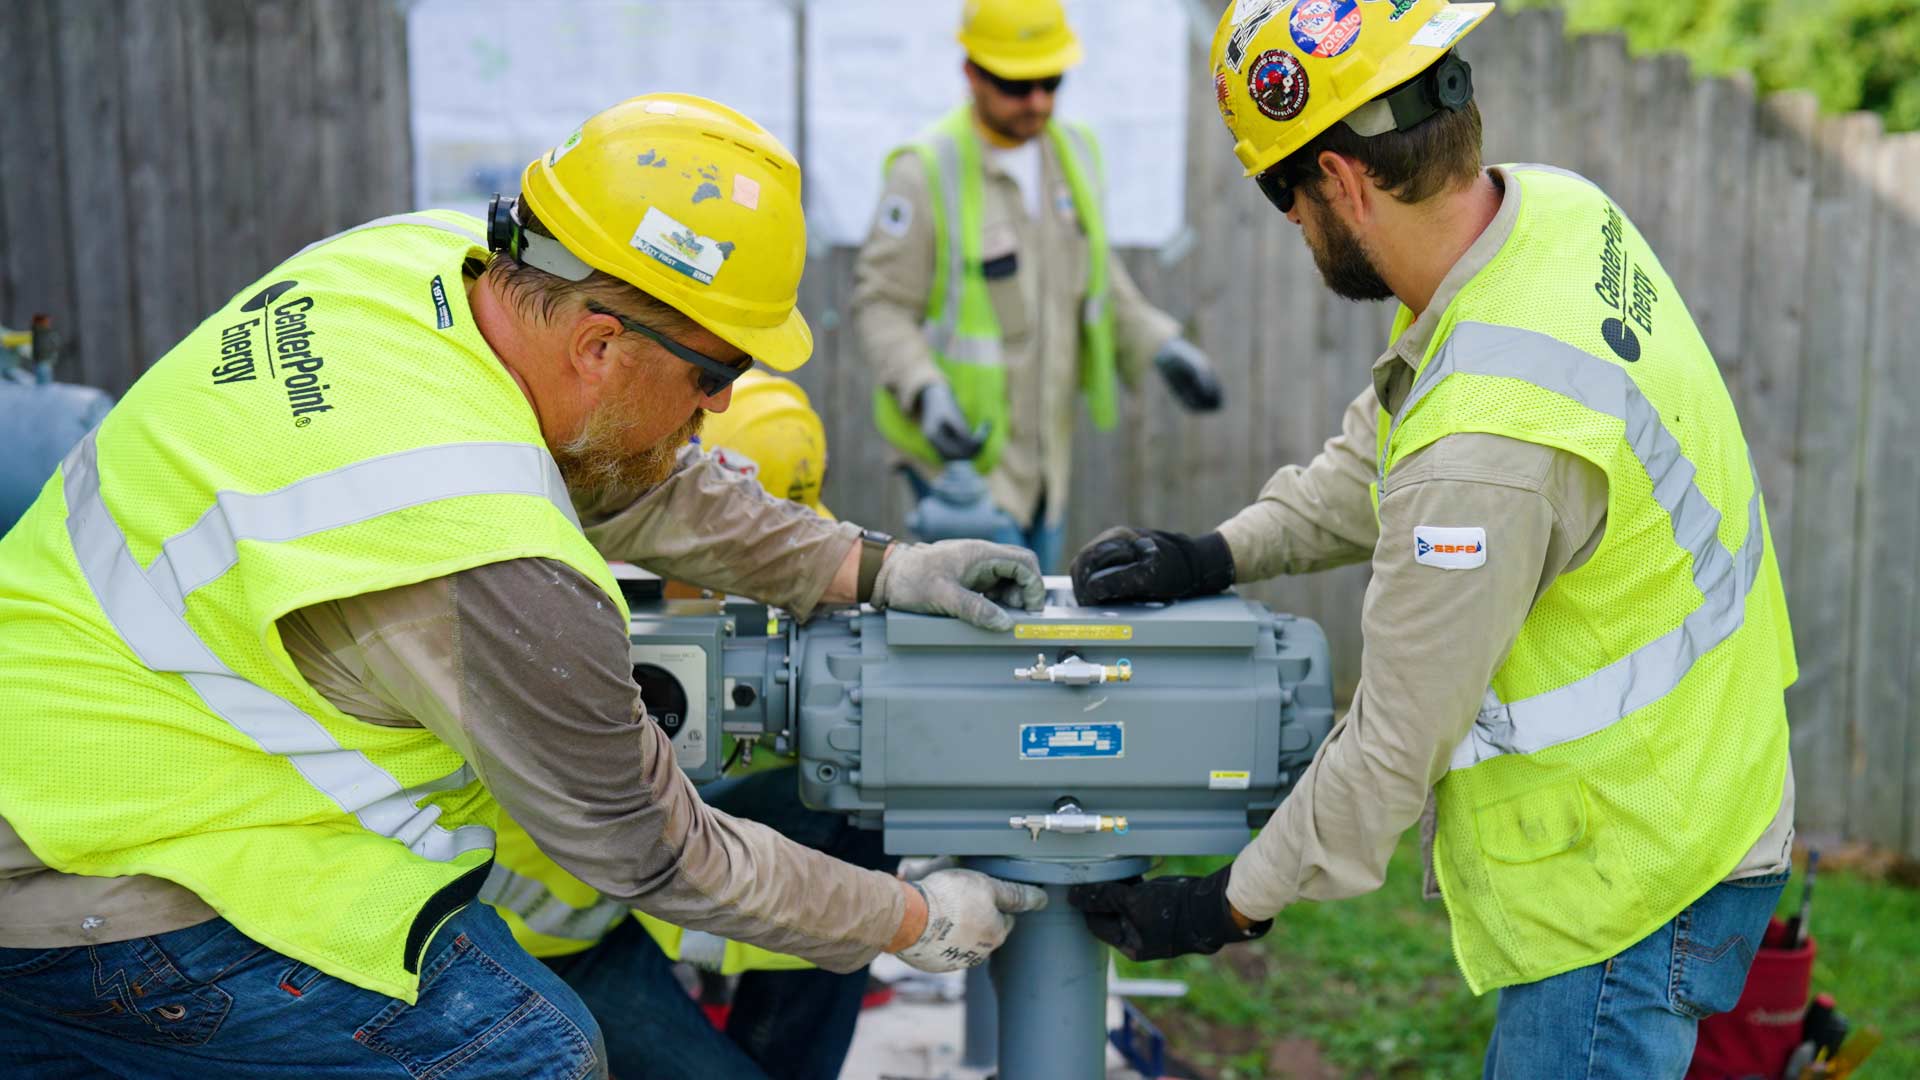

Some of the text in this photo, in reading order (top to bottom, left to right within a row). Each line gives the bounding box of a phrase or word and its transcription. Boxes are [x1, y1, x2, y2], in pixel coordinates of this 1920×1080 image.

[1316, 29, 1344, 56] Vote
[1341, 13, 1360, 31] No
[658, 250, 678, 266] FIRST
[1628, 263, 1658, 336] Energy
[212, 317, 261, 385] Energy
[940, 946, 981, 967] HyFle
